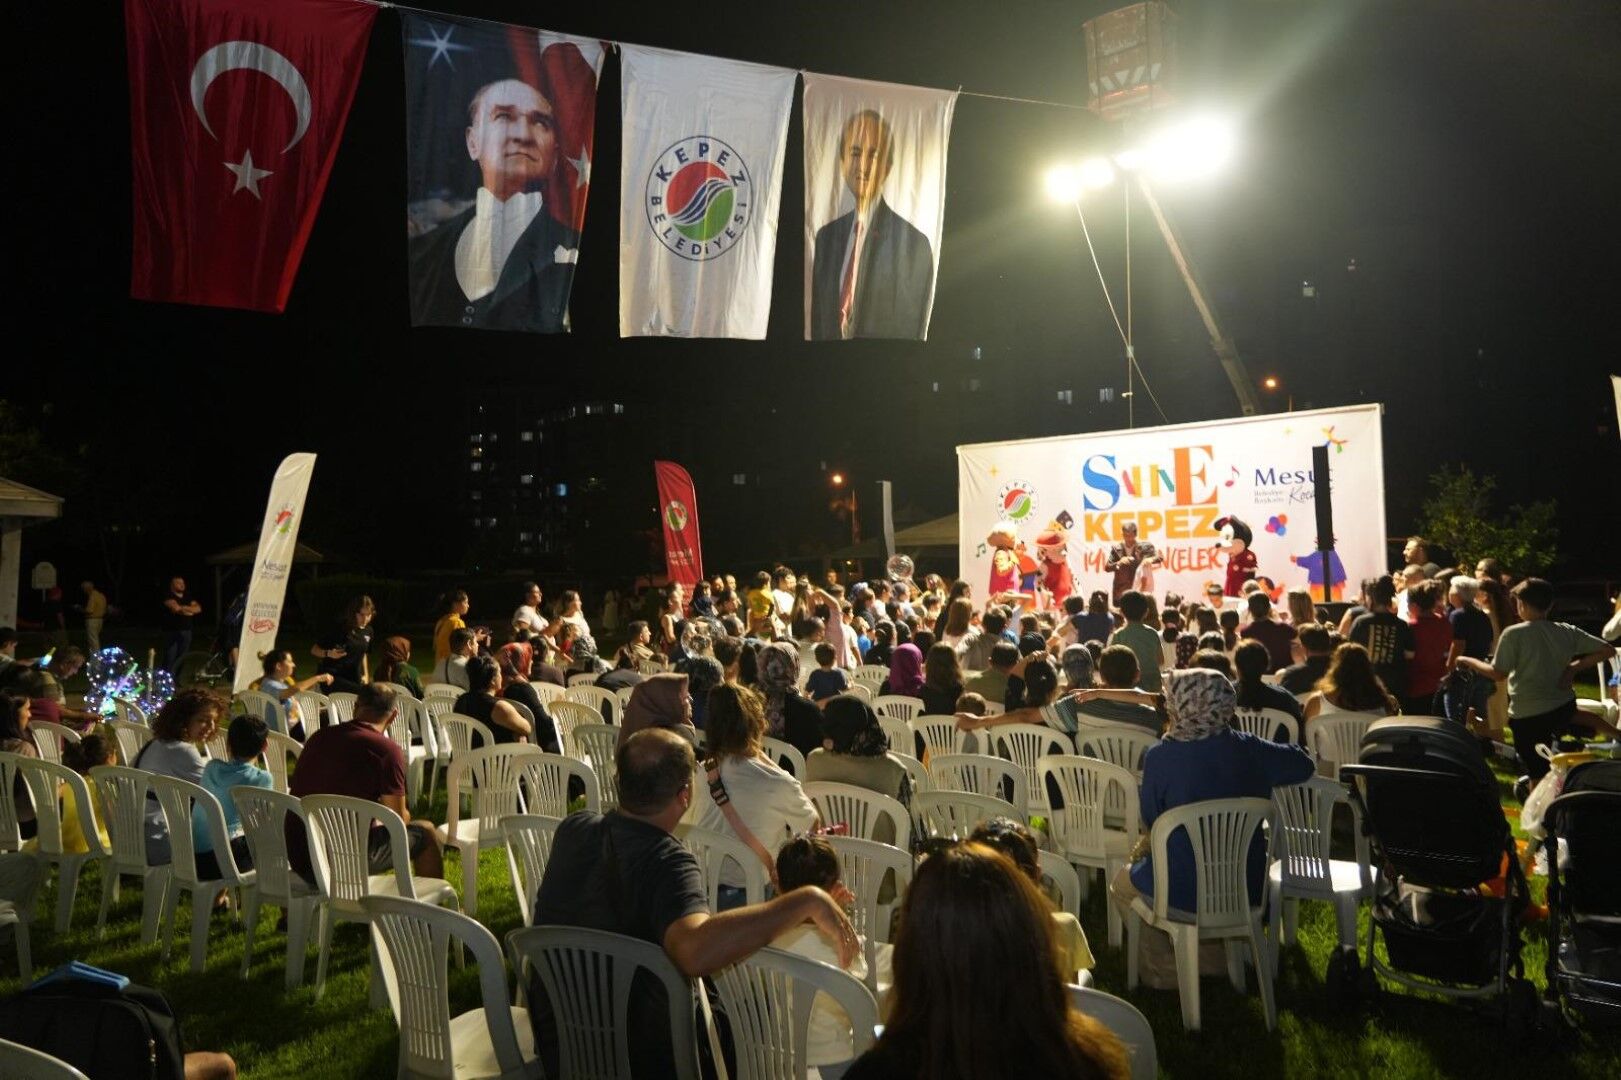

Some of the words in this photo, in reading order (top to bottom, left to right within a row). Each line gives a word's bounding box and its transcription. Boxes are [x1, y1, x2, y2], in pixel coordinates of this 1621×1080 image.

[656, 142, 746, 187] KEPEZ
[651, 195, 747, 255] BELEDİYESİ
[1084, 507, 1220, 542] KEPEZ
